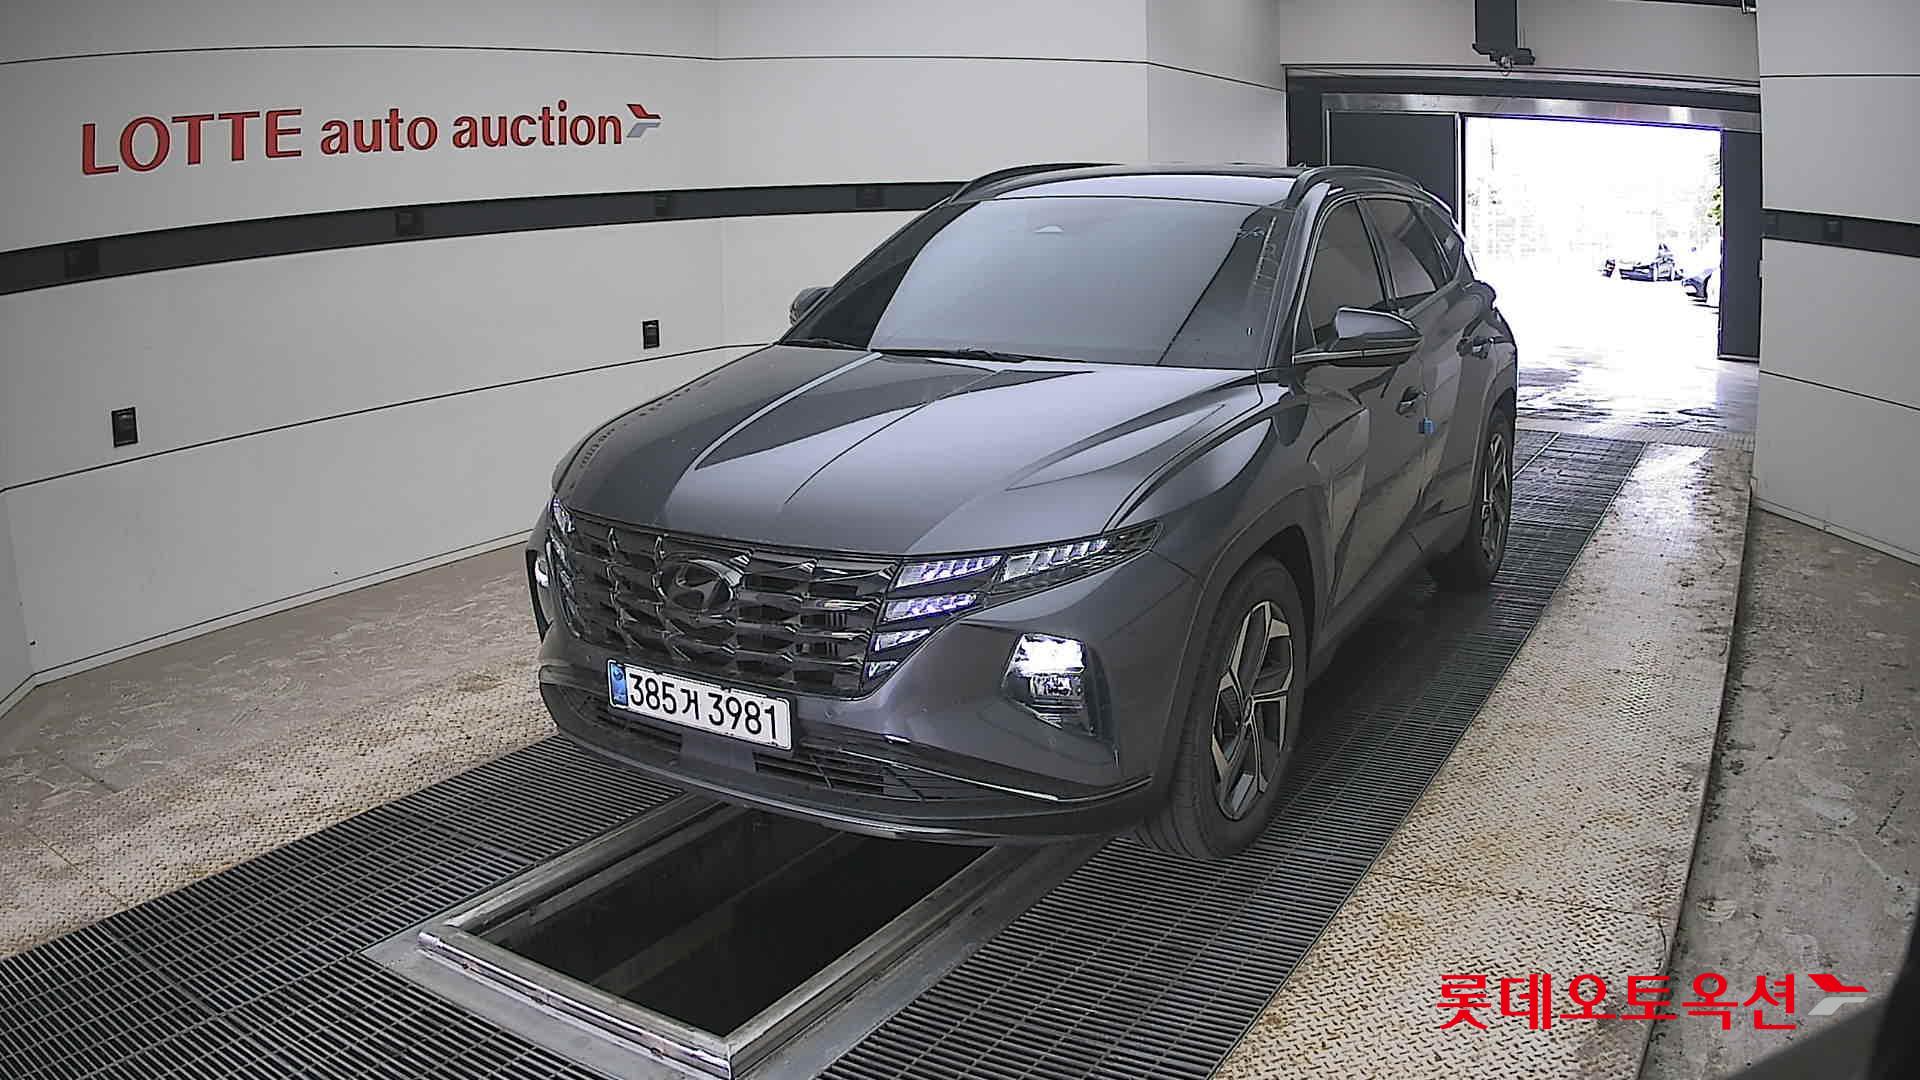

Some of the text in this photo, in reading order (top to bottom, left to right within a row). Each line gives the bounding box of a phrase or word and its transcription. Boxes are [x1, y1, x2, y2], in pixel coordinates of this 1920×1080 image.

[82, 99, 622, 176] LOTTE auto auction
[708, 692, 778, 740] 3981
